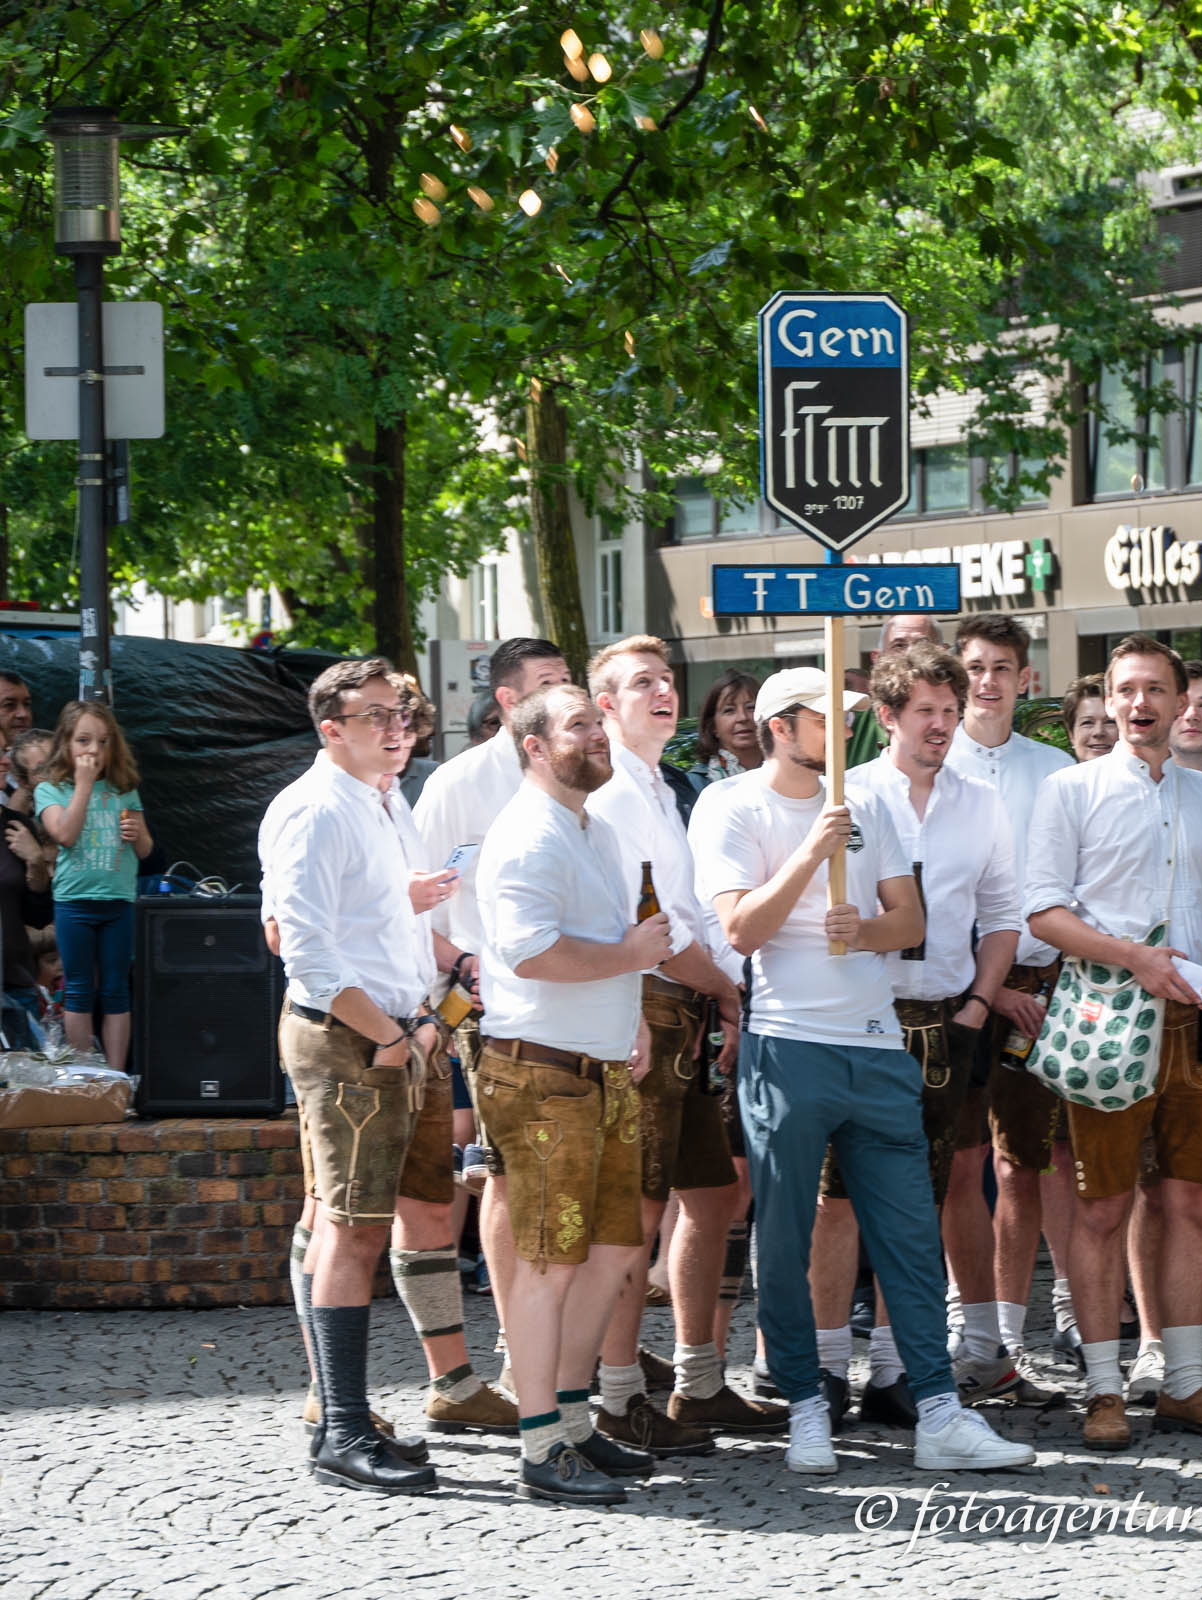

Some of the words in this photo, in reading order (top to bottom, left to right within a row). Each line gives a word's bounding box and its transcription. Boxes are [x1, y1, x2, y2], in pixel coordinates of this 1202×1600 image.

[778, 309, 895, 358] Gern
[1104, 524, 1200, 590] Eilles
[844, 573, 935, 609] Gern
